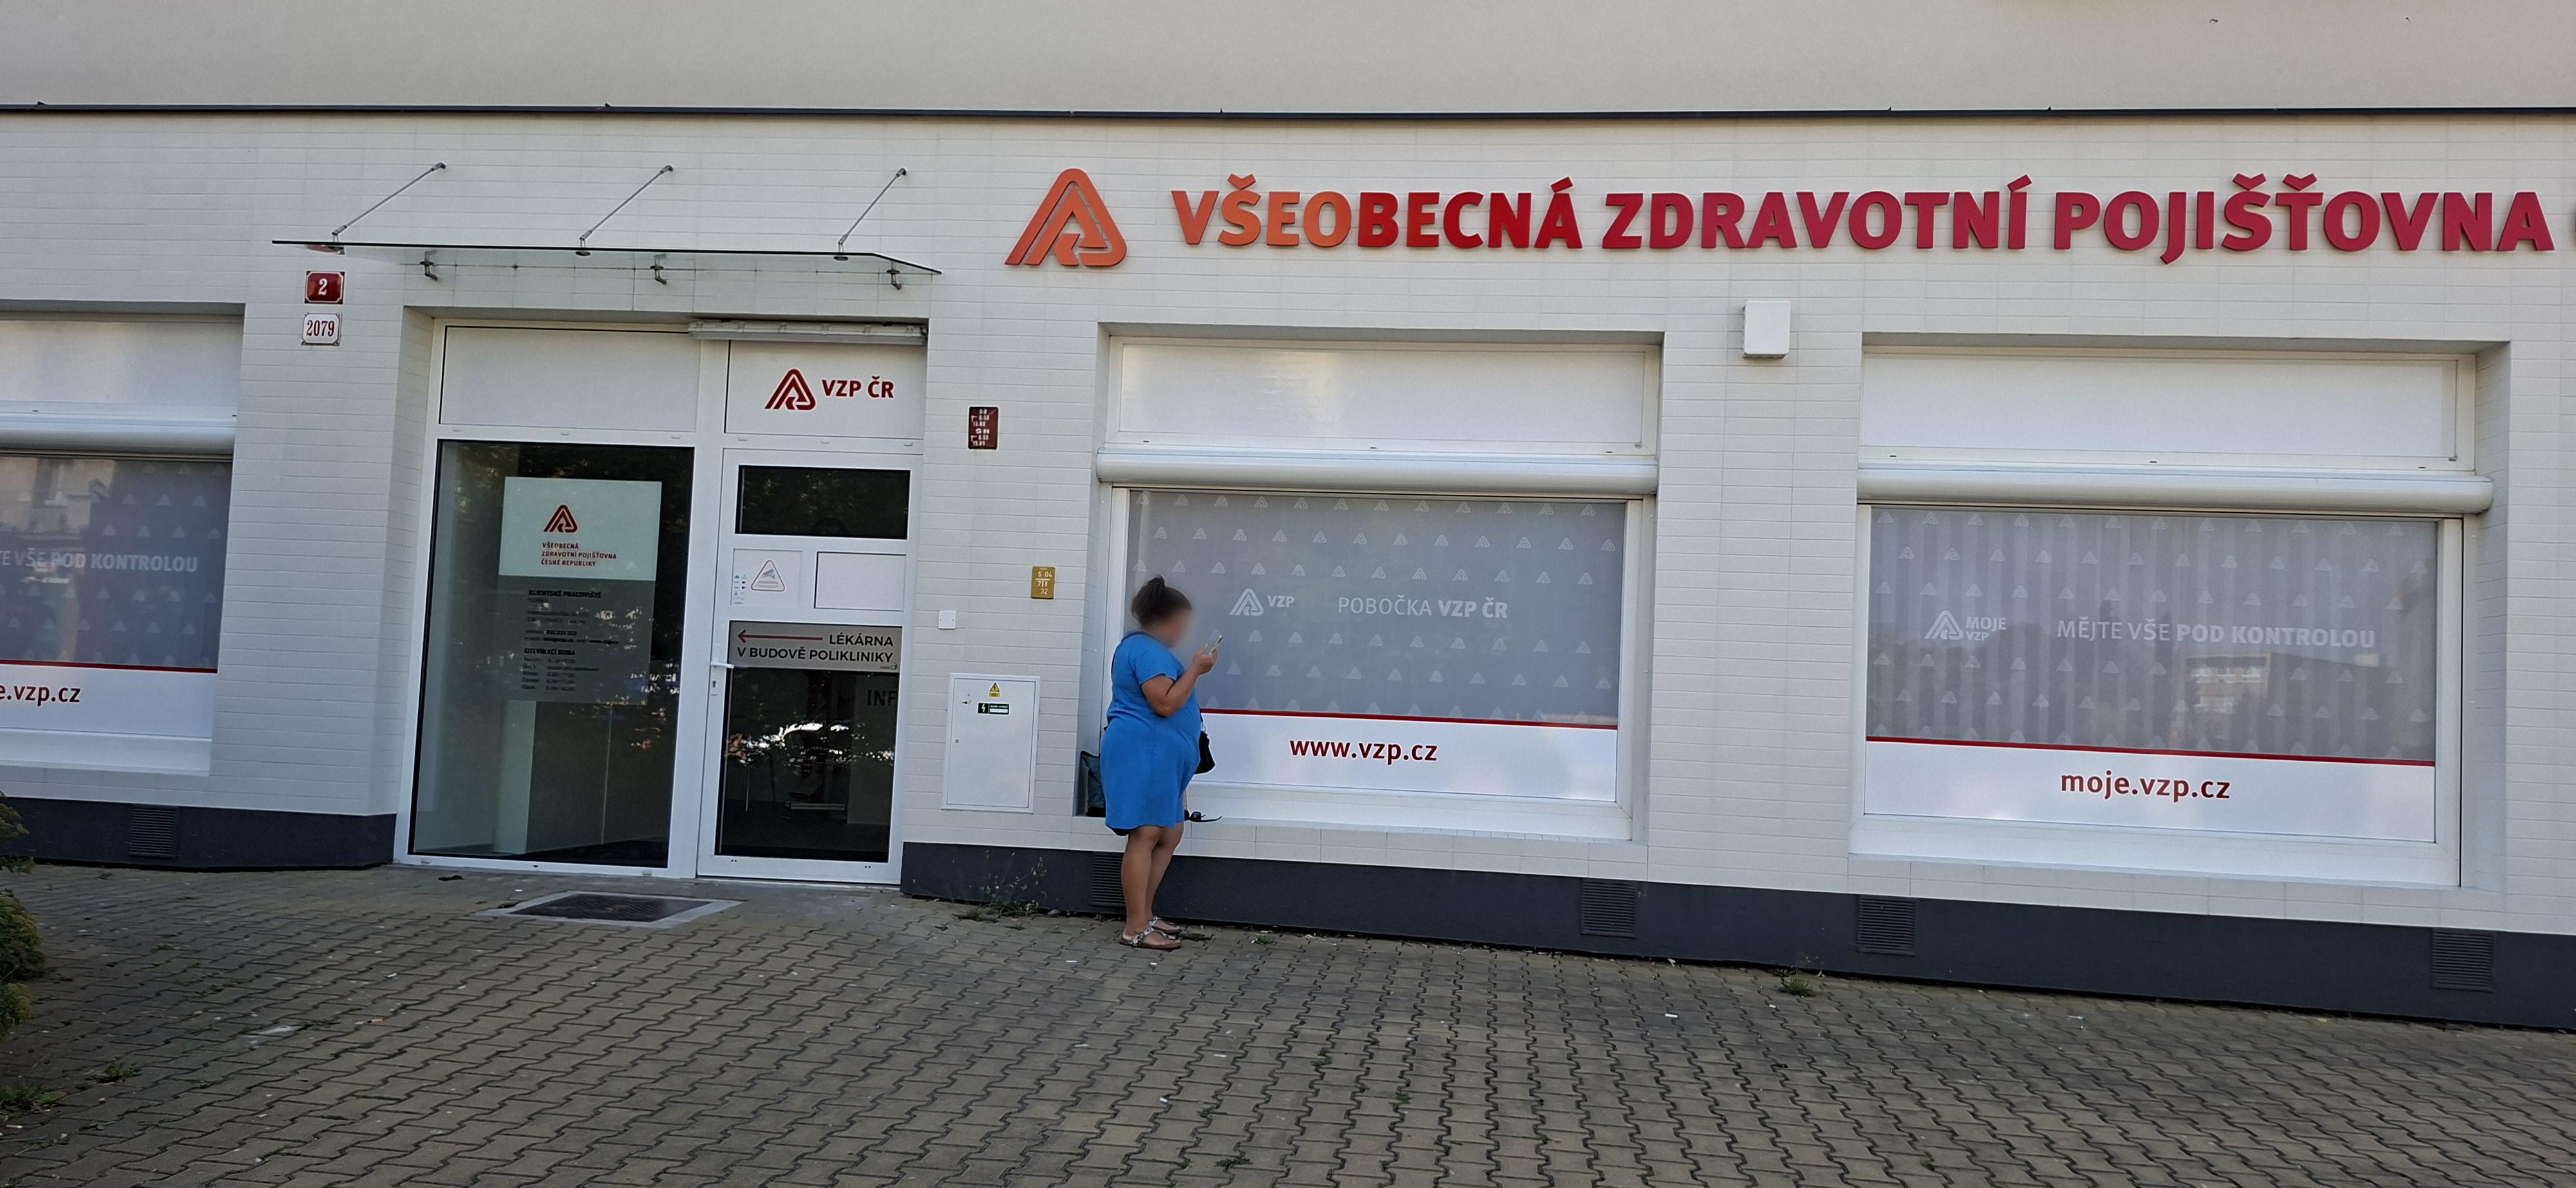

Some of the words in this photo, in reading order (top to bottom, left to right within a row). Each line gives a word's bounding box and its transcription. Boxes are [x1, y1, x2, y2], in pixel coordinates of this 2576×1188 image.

[1171, 173, 1583, 250] VŠEOBECNÁ
[1601, 174, 2033, 250] ZDRAVOTNÍ
[2054, 173, 2555, 264] POJIŠŤOVNA
[318, 278, 328, 295] 2
[306, 320, 335, 336] 2079
[821, 379, 862, 398] VZP
[867, 376, 894, 399] ČR
[542, 541, 579, 550] VŠEOBECNÁ
[51, 551, 86, 568] POD
[91, 553, 198, 572] KONTROLOU
[1267, 595, 1295, 608] VZP
[1338, 593, 1432, 617] POBOČKA
[1438, 600, 1476, 617] VZP
[1481, 597, 1508, 619] ČR
[1966, 616, 2007, 631] MOJE
[829, 632, 894, 647] LÉKÁRNA
[1966, 631, 1989, 642] VZP
[2058, 617, 2122, 642] MĚJTE
[2128, 617, 2170, 641] VŠE
[2176, 623, 2225, 644] POD
[2231, 626, 2376, 648] KONTROLOU
[737, 647, 746, 657] V
[749, 646, 806, 660] BUDOVĚ
[809, 649, 894, 663] POLIKLINIKY
[1290, 737, 1439, 765] www.vzp.cz
[2060, 770, 2231, 803] moje.vzp.cz
